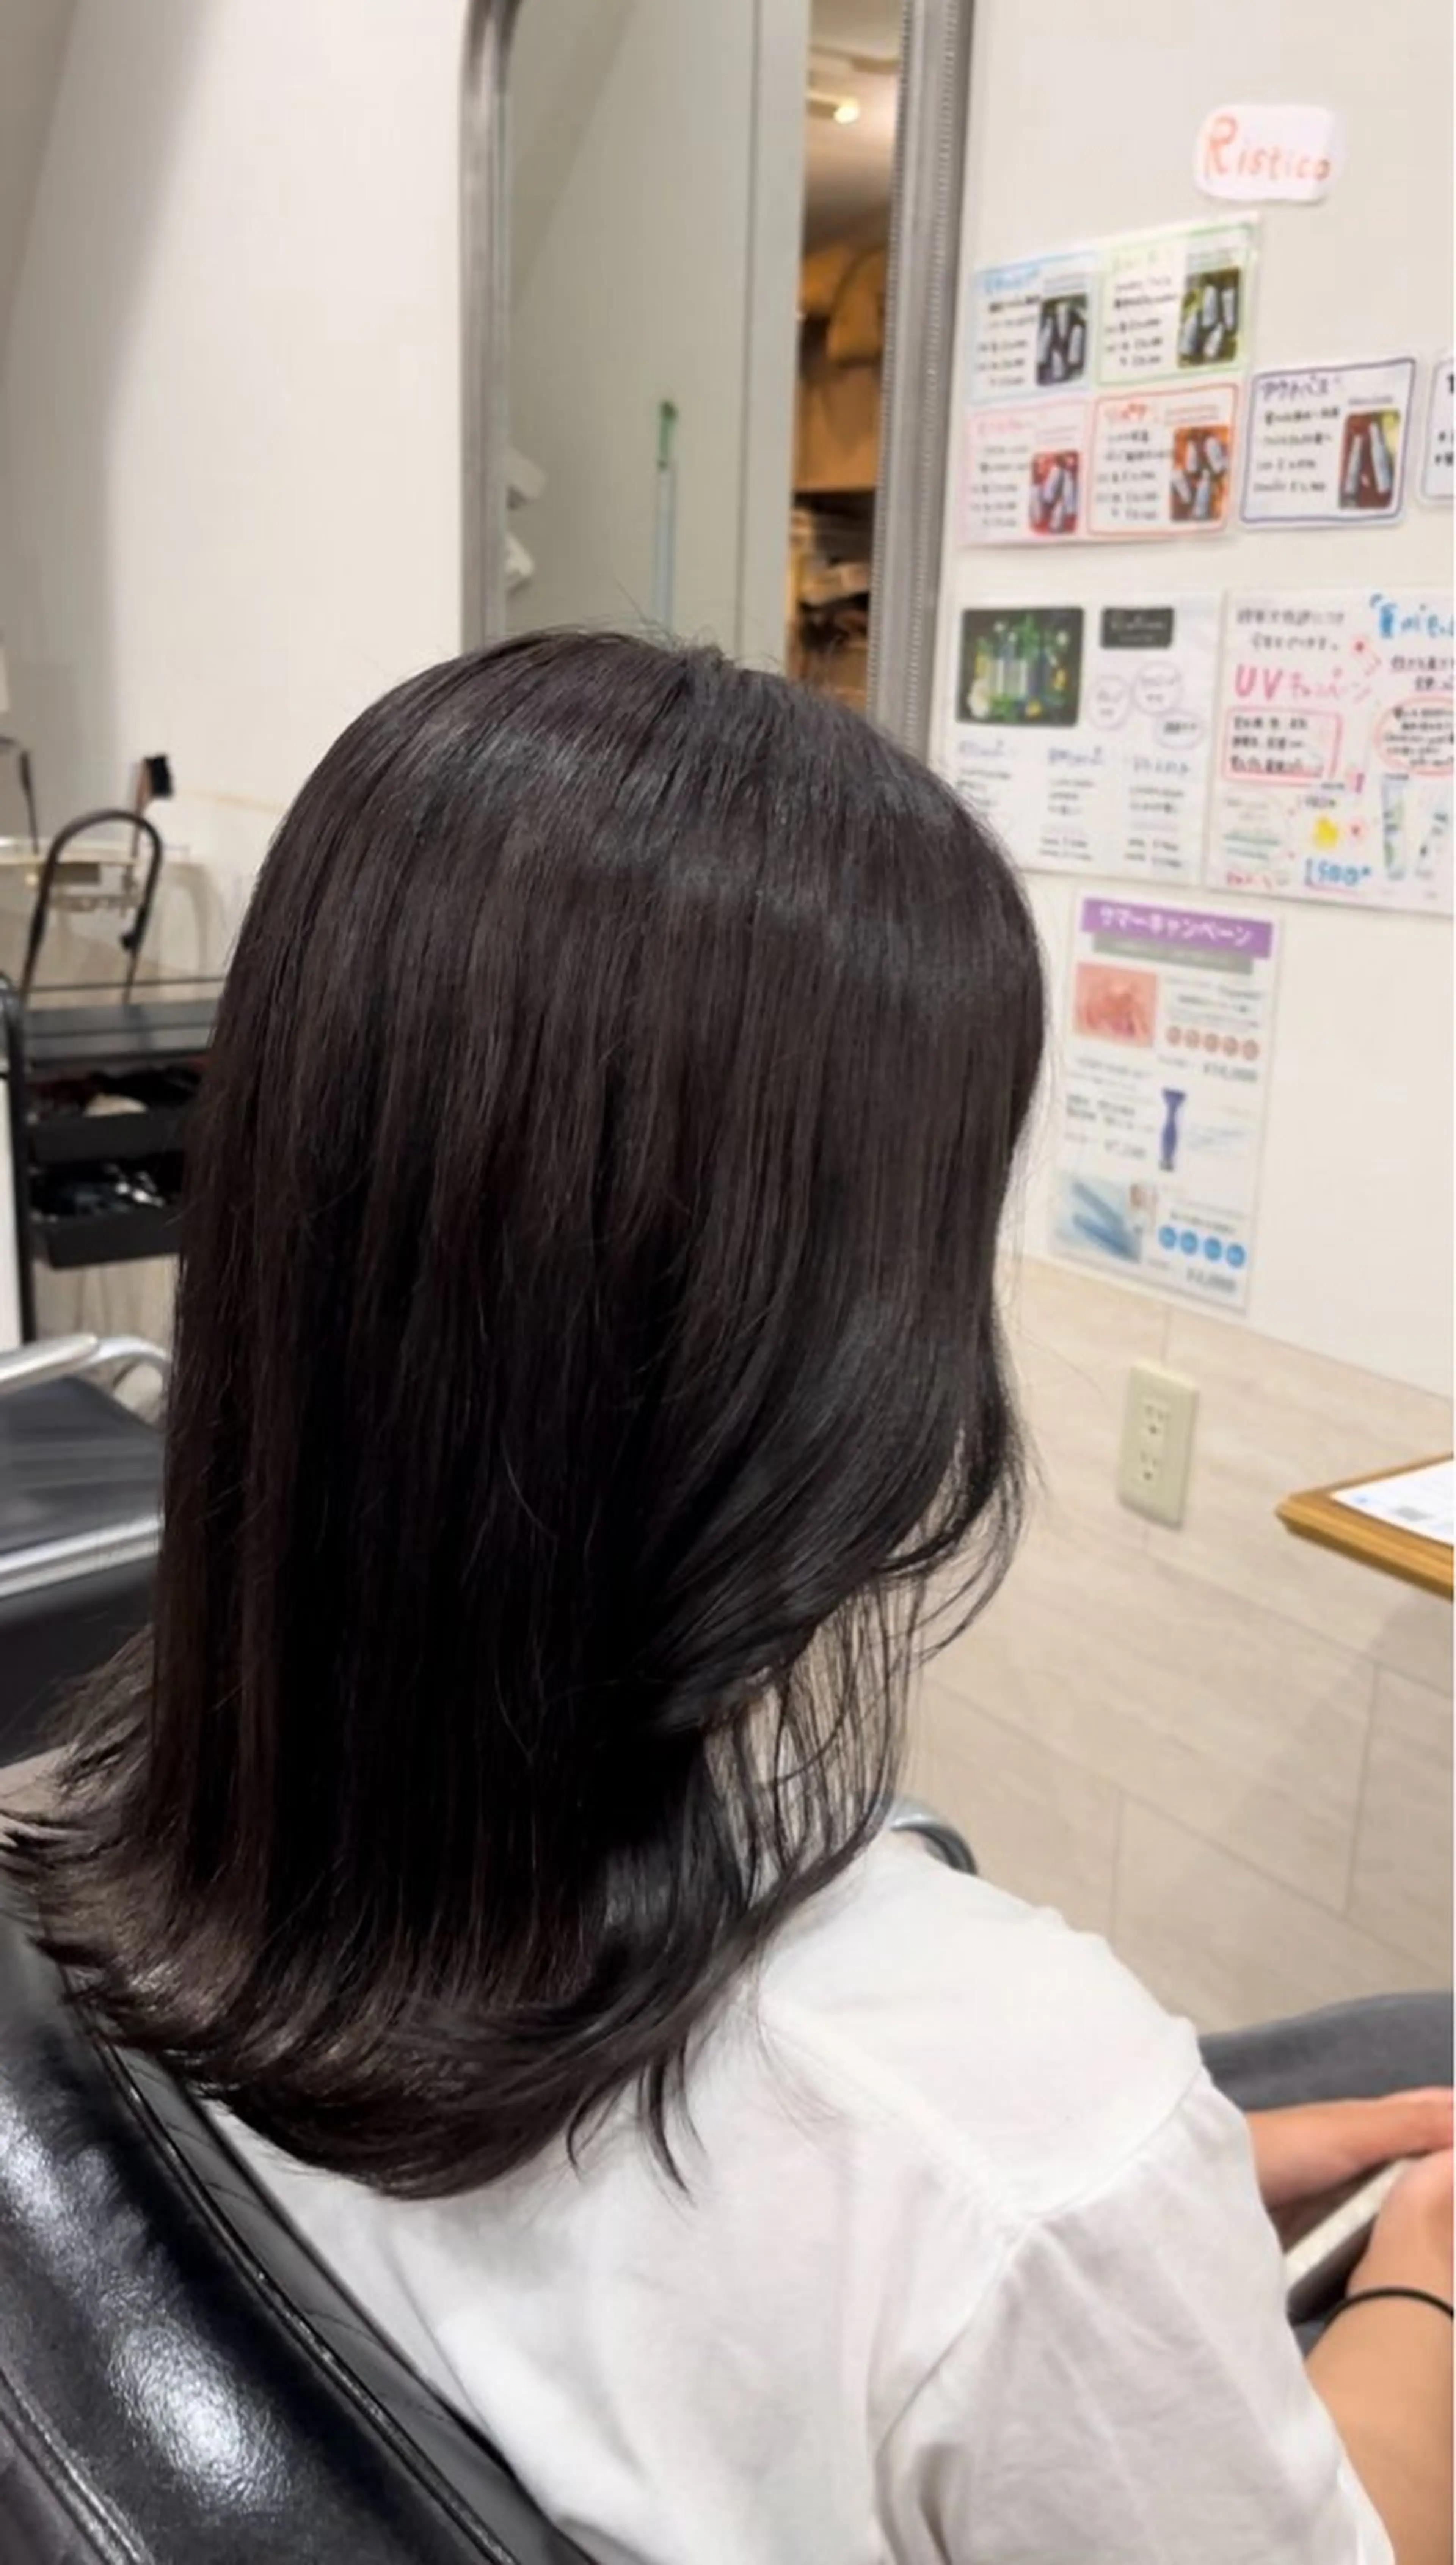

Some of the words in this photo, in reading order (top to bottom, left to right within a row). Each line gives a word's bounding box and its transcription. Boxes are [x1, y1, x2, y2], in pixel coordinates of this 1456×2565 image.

[1203, 115, 1332, 181] Ristico
[1100, 906, 1254, 947] サマーキャンペーン
